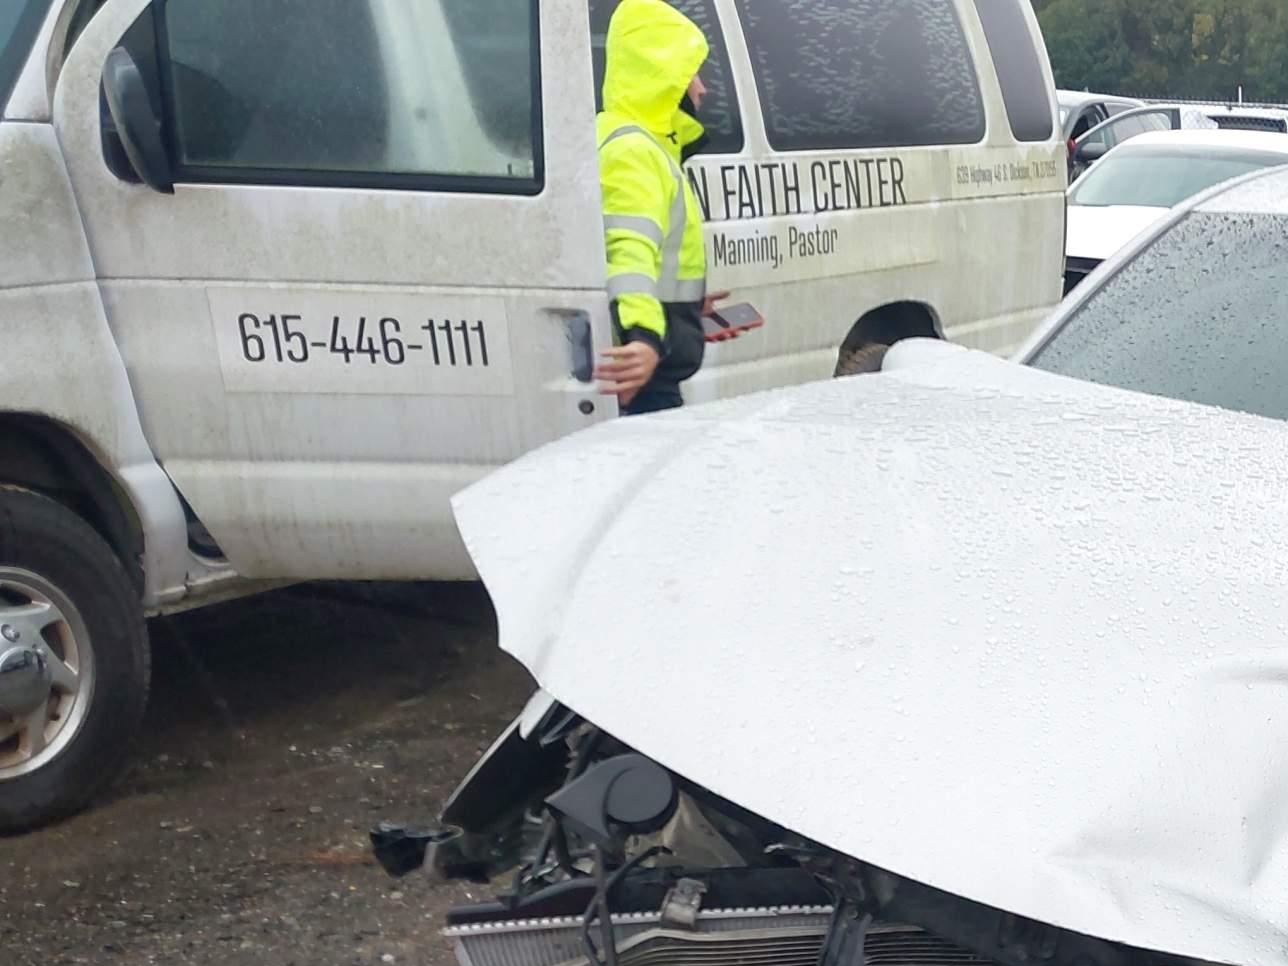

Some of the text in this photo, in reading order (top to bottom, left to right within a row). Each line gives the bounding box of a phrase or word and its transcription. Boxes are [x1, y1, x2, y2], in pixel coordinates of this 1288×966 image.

[720, 162, 801, 220] FAITH
[811, 157, 907, 216] CENTER
[713, 224, 839, 269] Manning, Pastor
[238, 313, 489, 367] 615-446-1111
